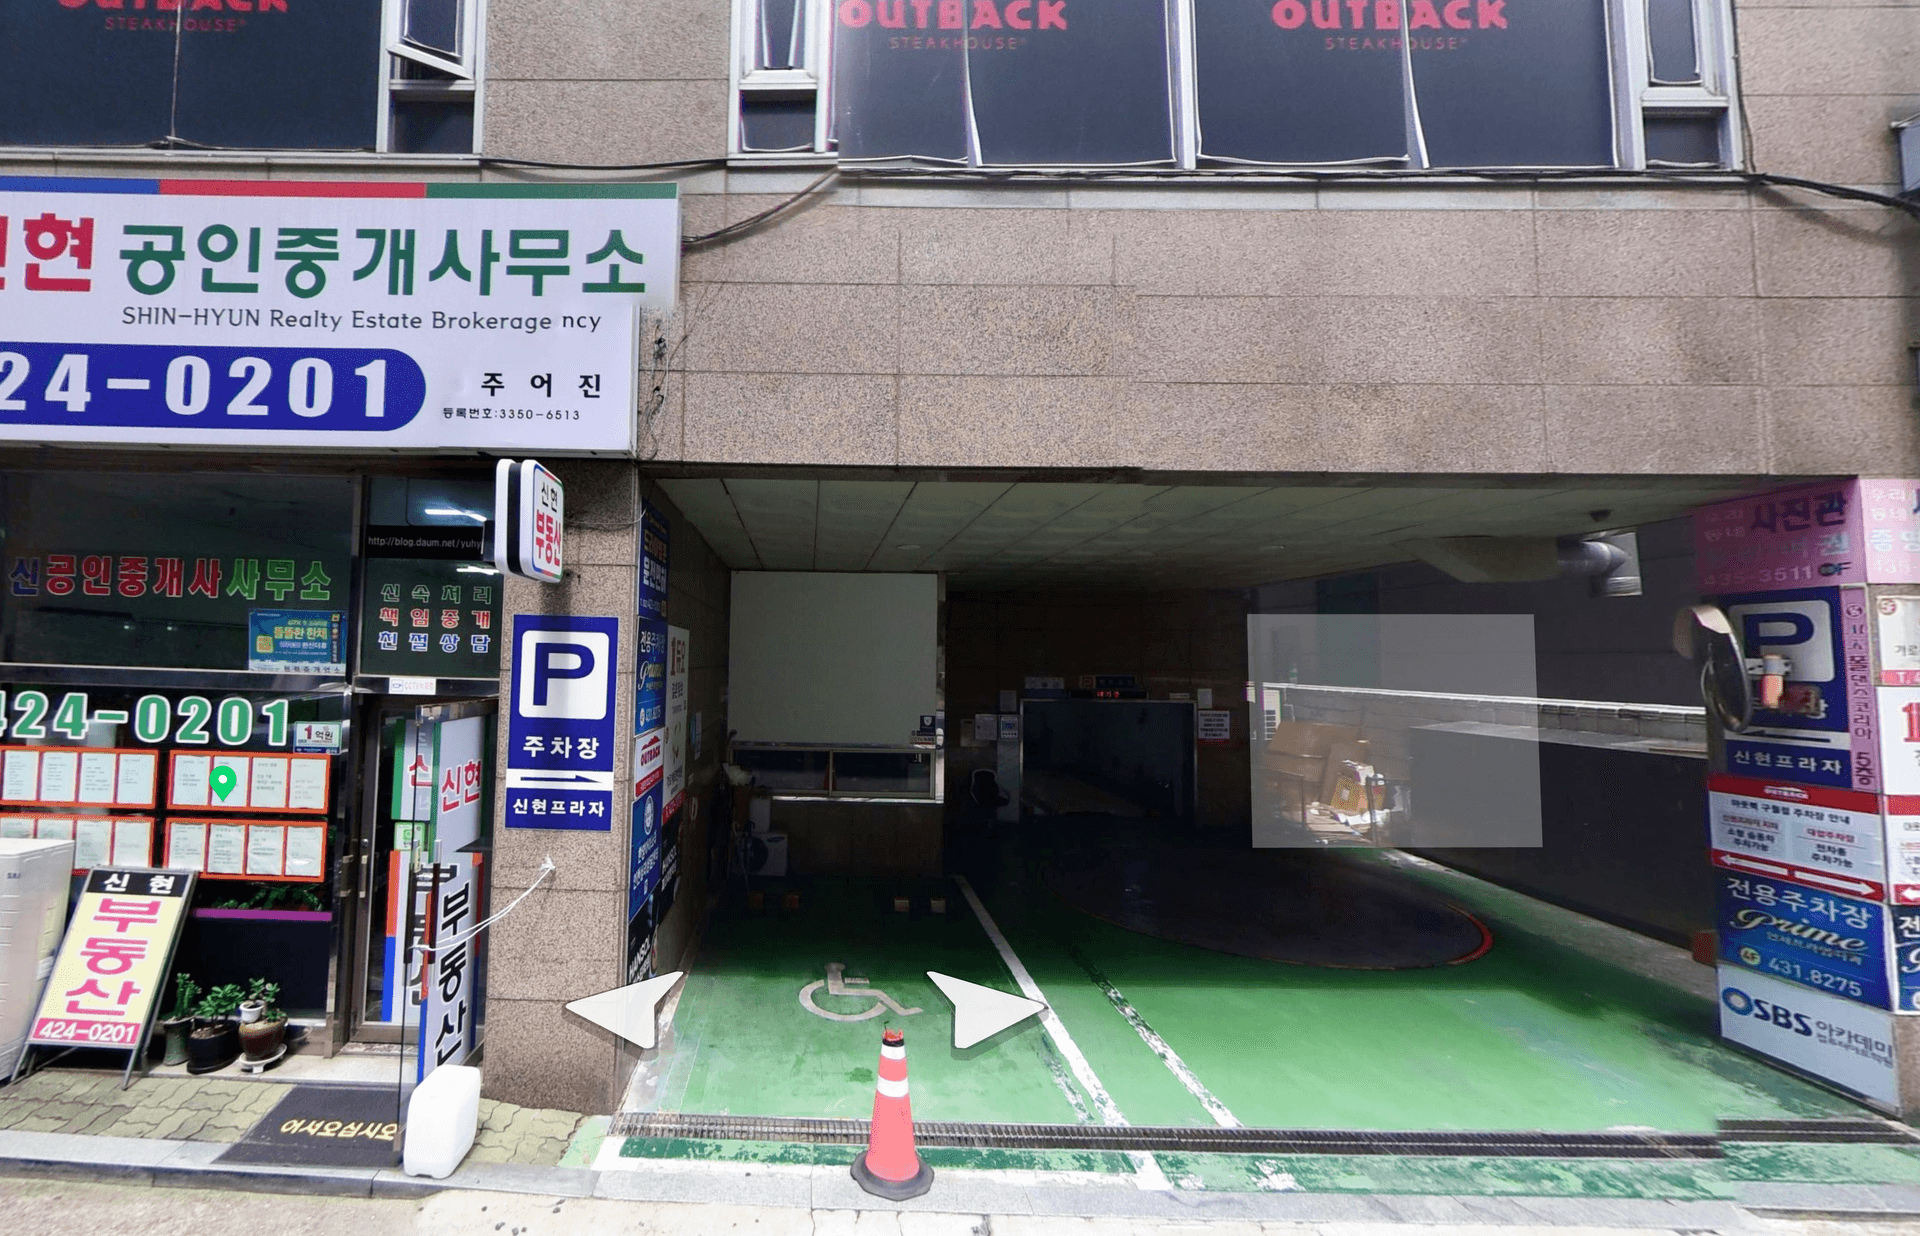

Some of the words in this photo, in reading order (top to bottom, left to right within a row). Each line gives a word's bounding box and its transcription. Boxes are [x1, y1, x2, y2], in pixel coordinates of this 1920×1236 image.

[839, 0, 1068, 30] OUTBACK
[1271, 0, 1508, 30] OUTBACK
[0, 213, 95, 292] 현
[119, 223, 647, 299] 공인중개사무소
[122, 306, 260, 328] SHIN-HYUN
[270, 309, 342, 333] Realty
[351, 310, 422, 330] Estate
[432, 311, 552, 334] Brokerage
[541, 481, 558, 513] 신현
[536, 508, 562, 567] 부동산
[533, 642, 595, 706] P
[0, 690, 289, 747] 24-0201
[522, 736, 600, 760] 주차장
[1733, 750, 1843, 775] 신현프라자
[442, 760, 481, 812] 신현
[512, 798, 605, 818] 신현프라자
[104, 873, 176, 895] 신현
[1727, 877, 1873, 930] 전용주차장
[1729, 909, 1871, 952] Prime
[65, 897, 162, 1017] 부동산
[435, 882, 470, 1067] 부동산
[38, 1021, 136, 1044] 424-0201
[1815, 1020, 1893, 1060] 아카데미
